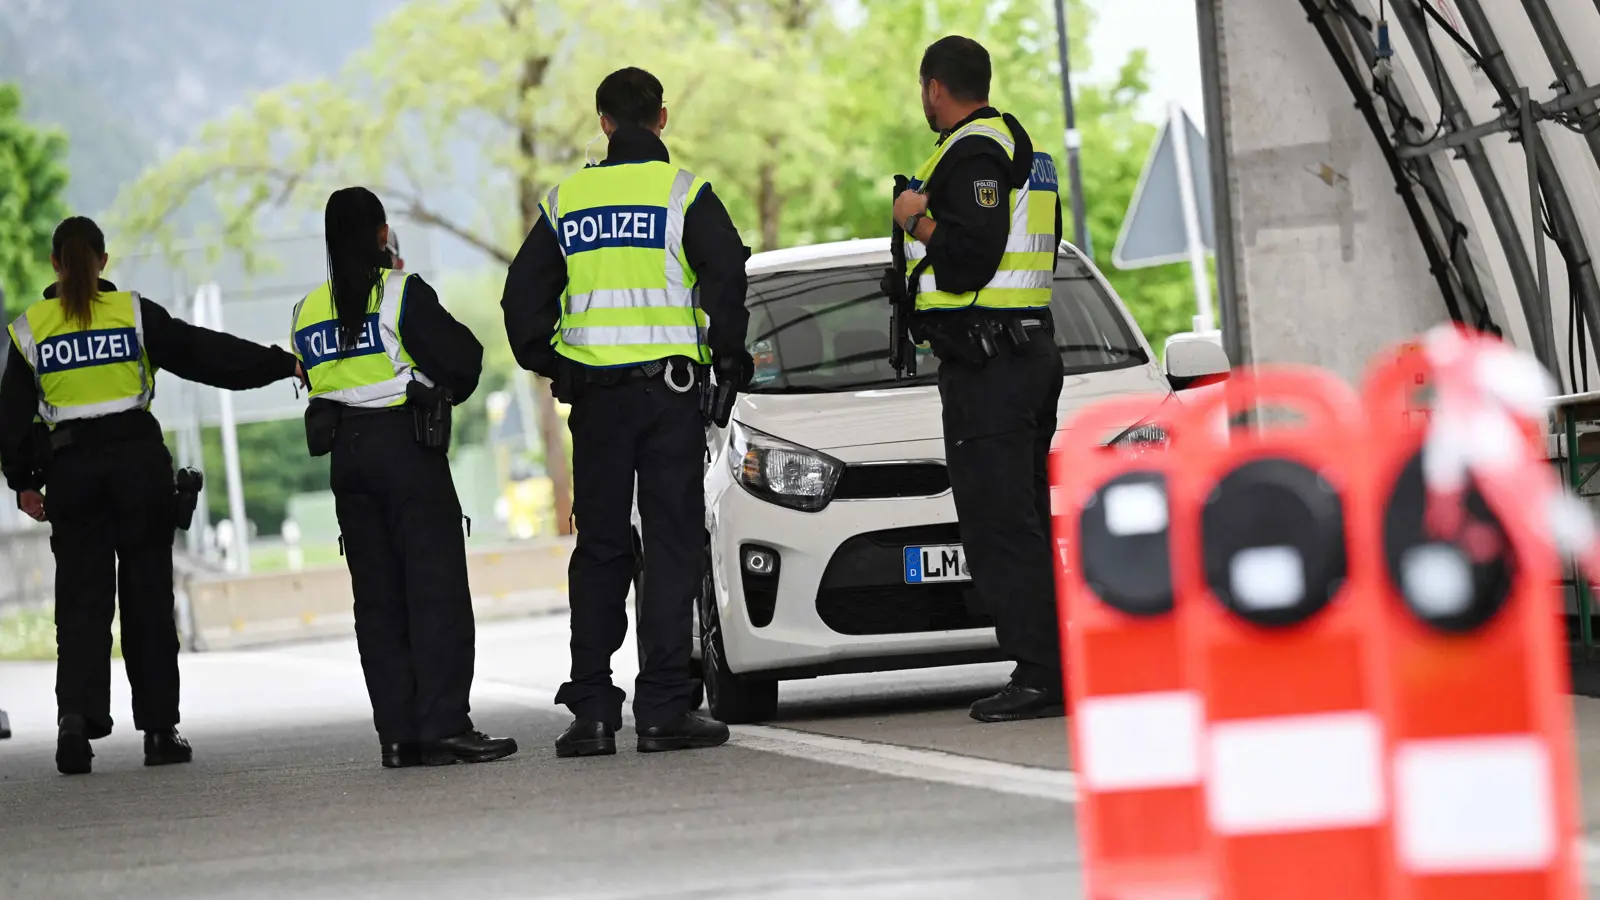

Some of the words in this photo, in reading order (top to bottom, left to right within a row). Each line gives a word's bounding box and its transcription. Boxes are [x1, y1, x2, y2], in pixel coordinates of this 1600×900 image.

[563, 212, 655, 247] POLIZEI
[41, 334, 130, 367] POLIZEI
[305, 322, 375, 357] POLIEI
[910, 569, 917, 577] D
[923, 550, 960, 577] LM
